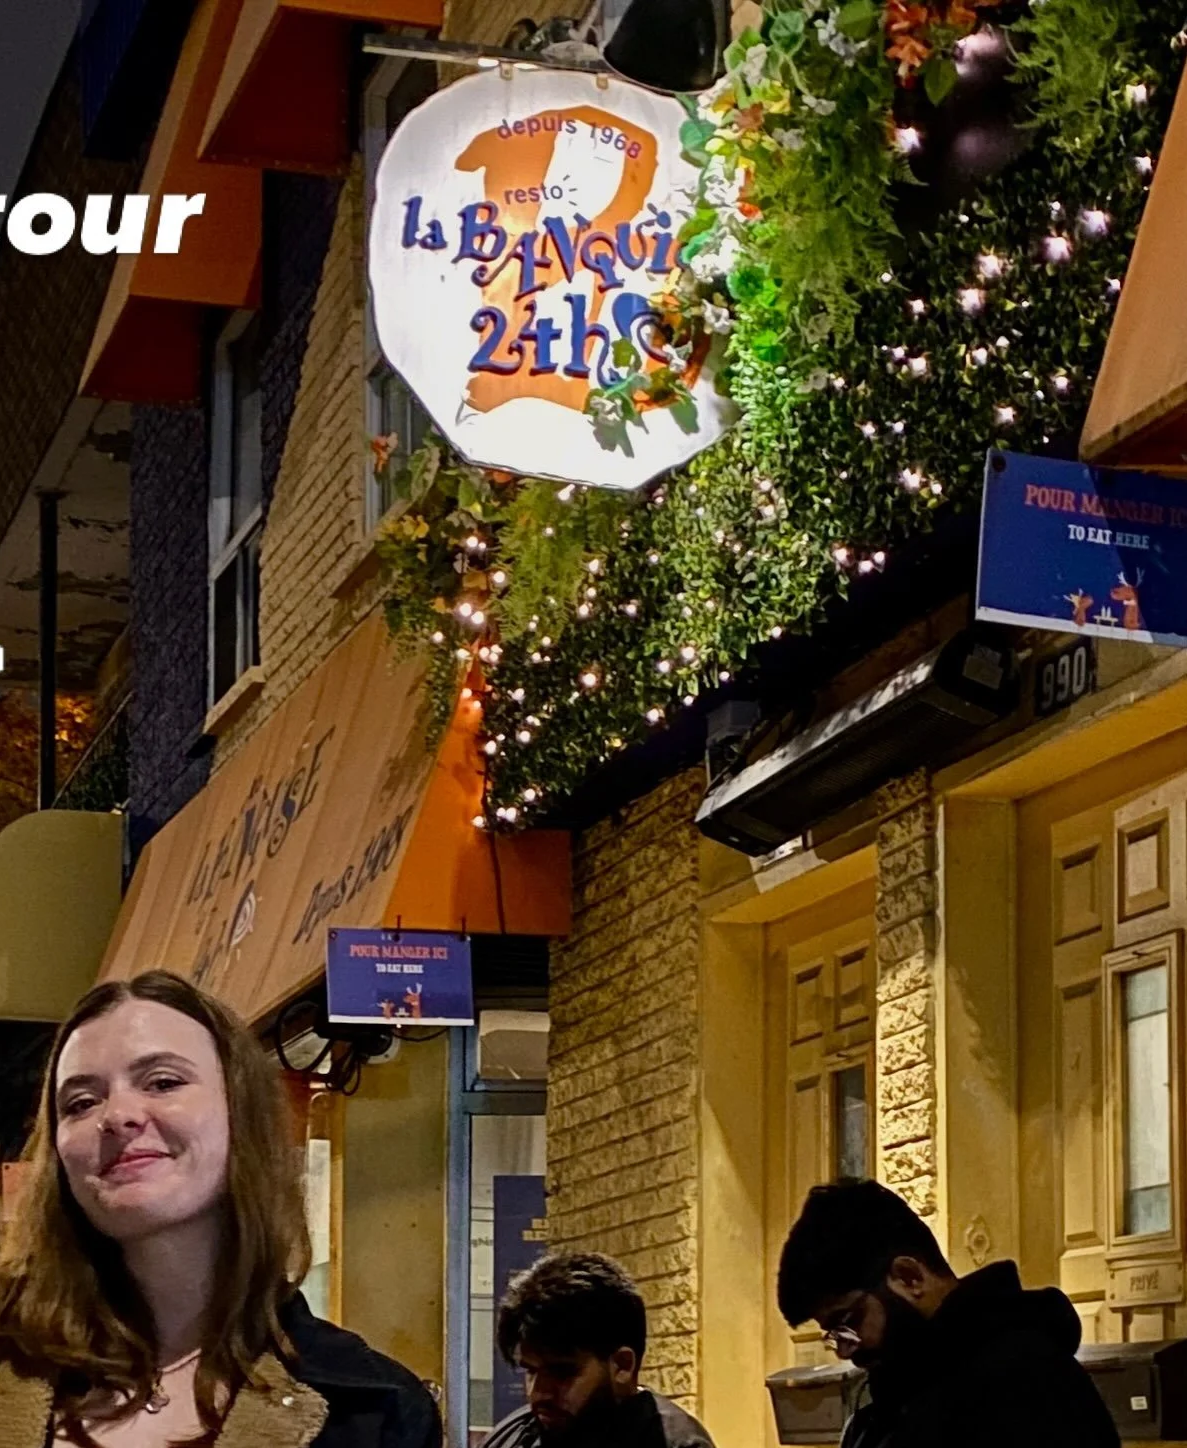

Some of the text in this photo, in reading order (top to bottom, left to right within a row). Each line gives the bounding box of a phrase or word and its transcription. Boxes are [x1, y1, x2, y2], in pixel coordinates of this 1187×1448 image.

[496, 115, 642, 160] depuis 1968
[503, 181, 564, 205] resto
[400, 195, 449, 251] la
[1024, 484, 1075, 513] POUR
[1080, 492, 1164, 525] MANGER
[1067, 523, 1150, 550] TO EAT HERE
[1041, 646, 1087, 711] 990
